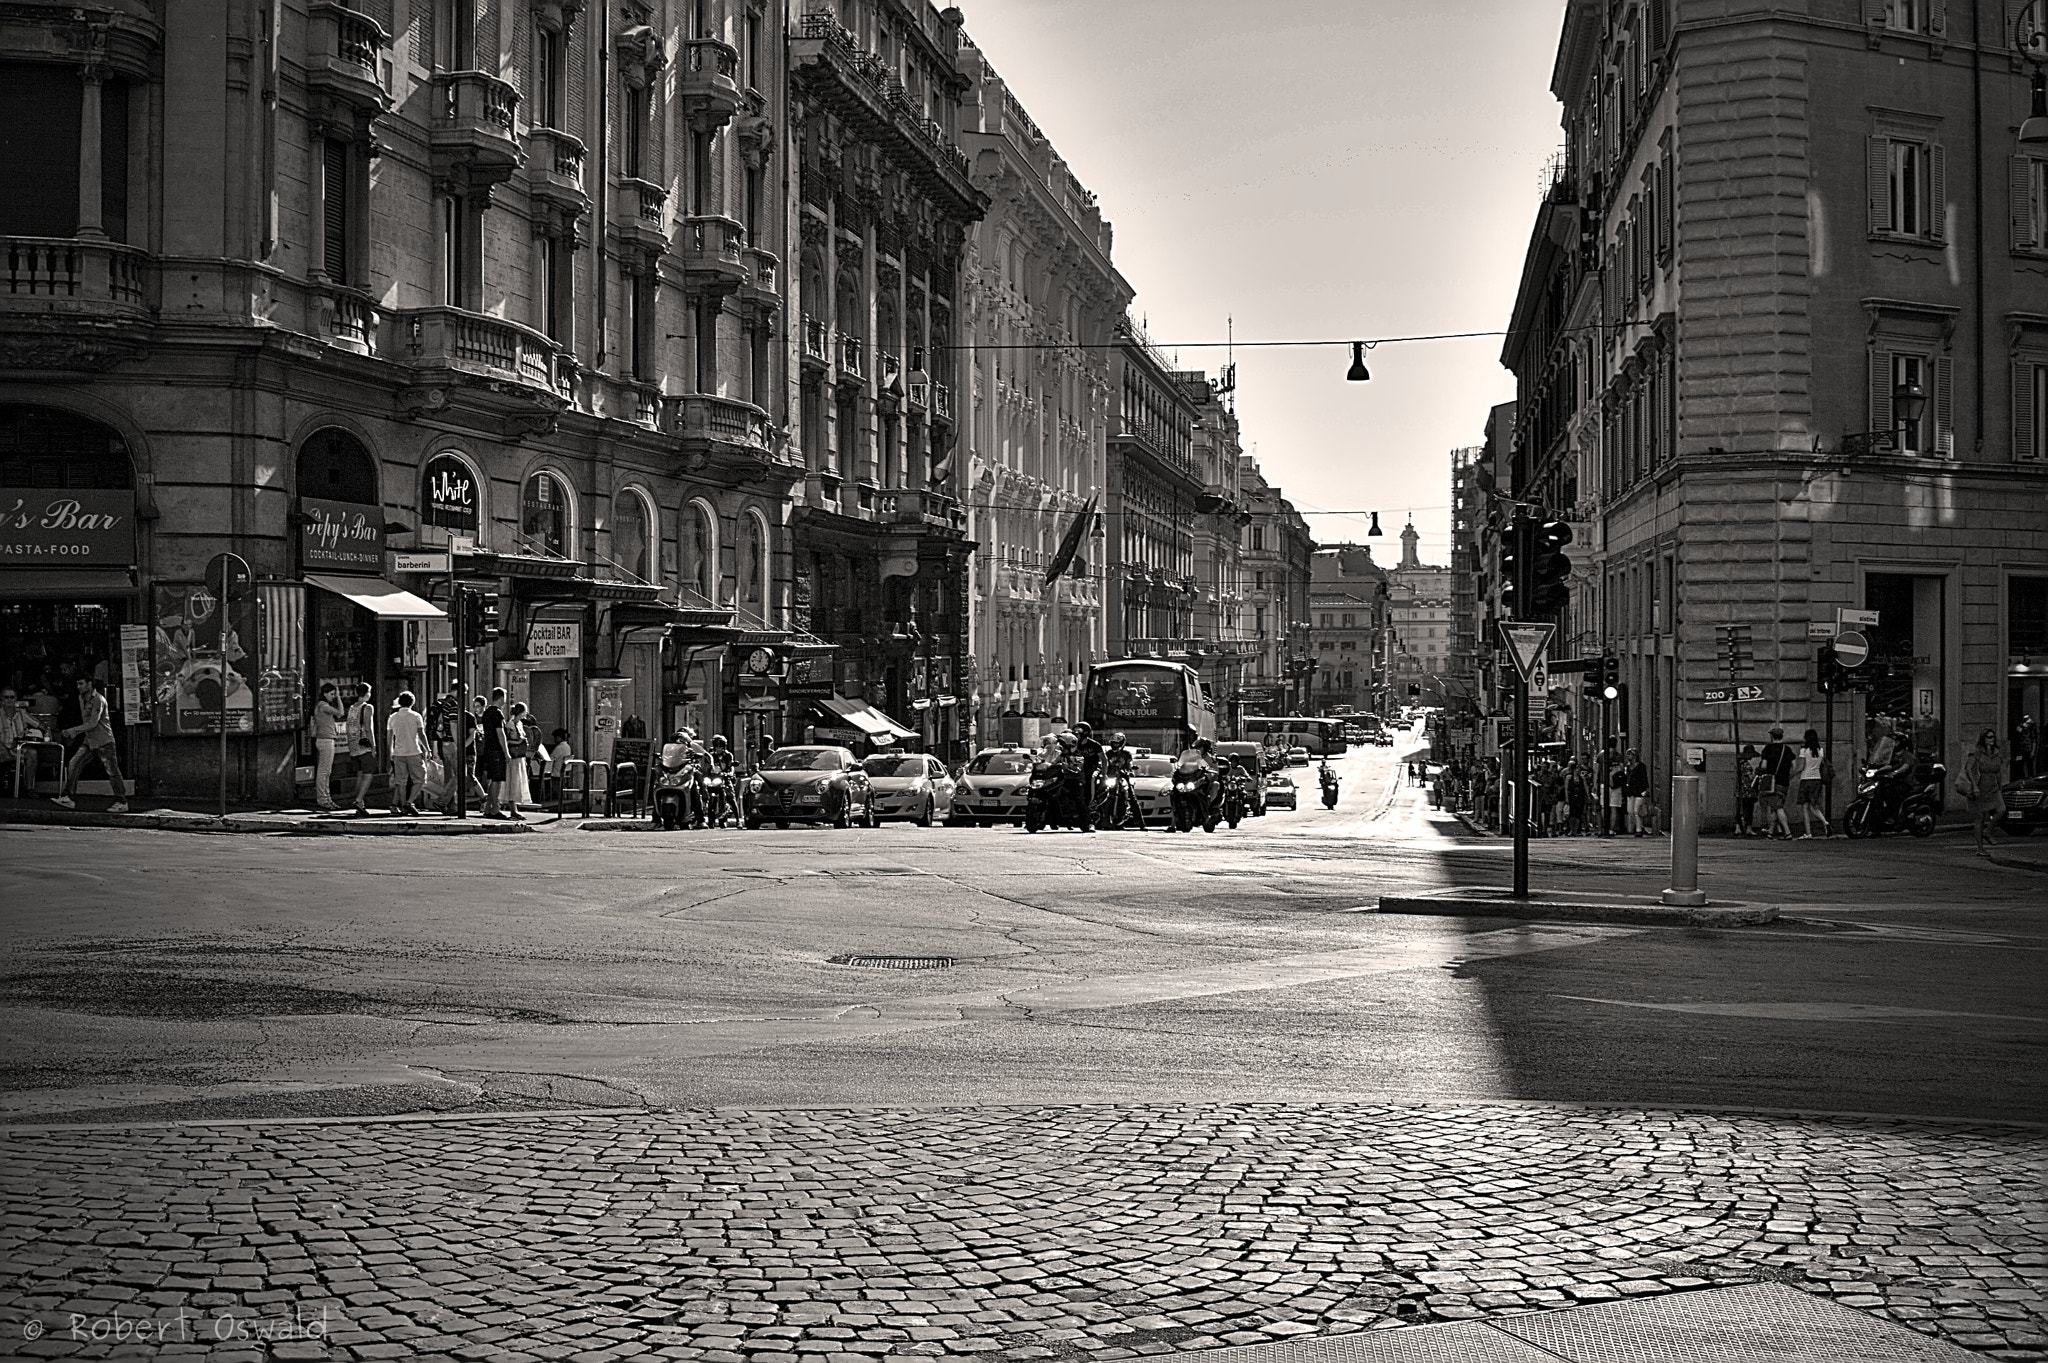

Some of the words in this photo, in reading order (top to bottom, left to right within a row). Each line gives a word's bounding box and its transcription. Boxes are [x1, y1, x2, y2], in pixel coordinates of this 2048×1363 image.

[431, 471, 472, 505] White
[41, 499, 123, 530] Bar
[351, 513, 377, 541] Bar
[397, 561, 431, 569] barberini
[556, 627, 571, 640] BAR
[534, 642, 544, 656] Ice
[545, 642, 566, 656] Cream
[1113, 708, 1135, 716] OPEN
[1136, 708, 1158, 716] TOUR
[828, 729, 862, 737] RISTORANTE
[833, 733, 856, 741] PIZZERIA
